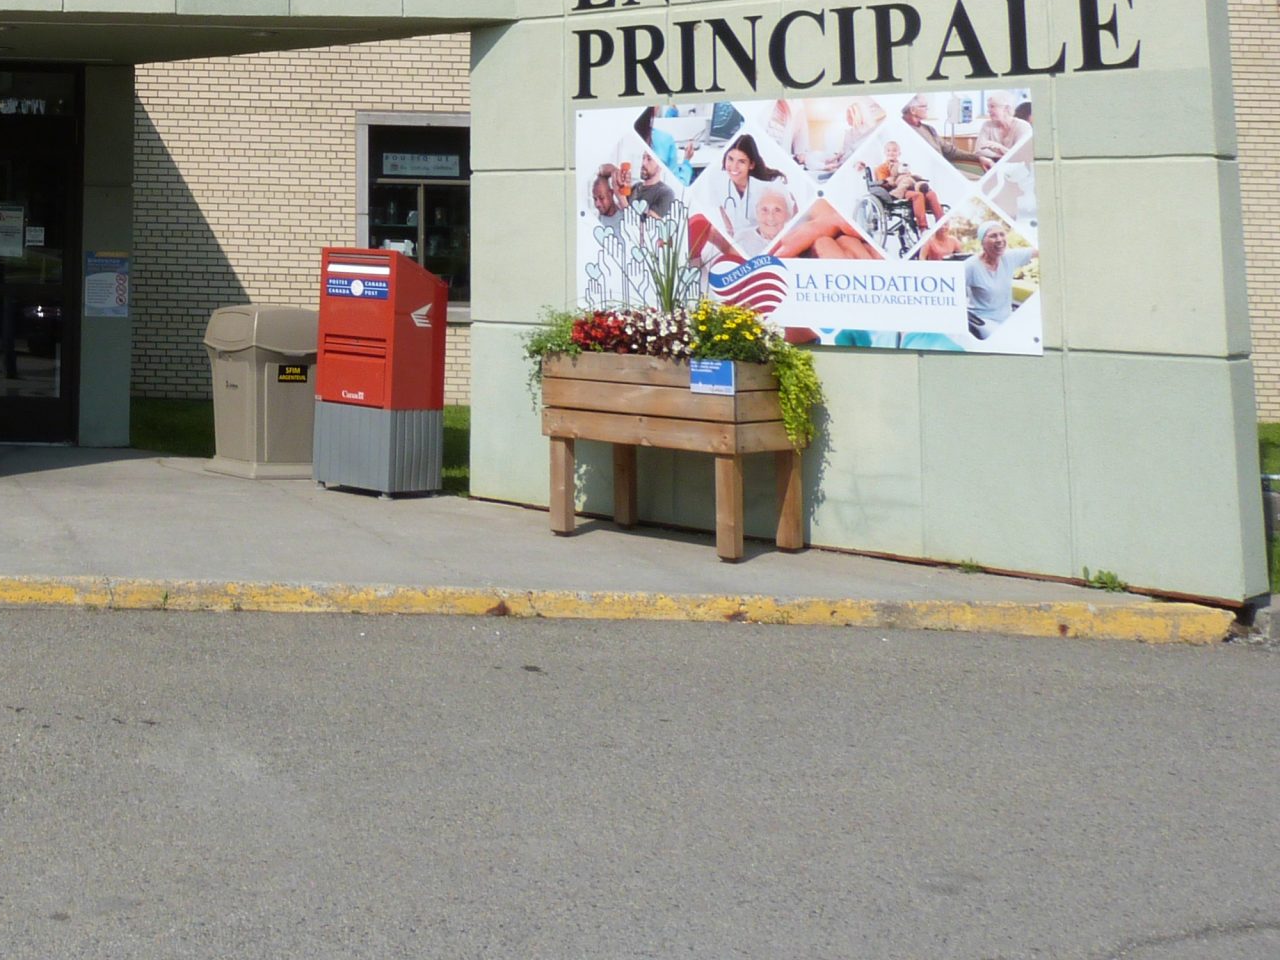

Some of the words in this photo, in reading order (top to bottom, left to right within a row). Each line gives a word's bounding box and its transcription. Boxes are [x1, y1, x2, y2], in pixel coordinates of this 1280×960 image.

[721, 263, 752, 286] DEPUIS
[752, 255, 772, 269] 2002
[328, 278, 348, 286] POSTES
[796, 273, 818, 289] LA
[824, 274, 956, 293] FONDATION
[796, 292, 811, 302] DE
